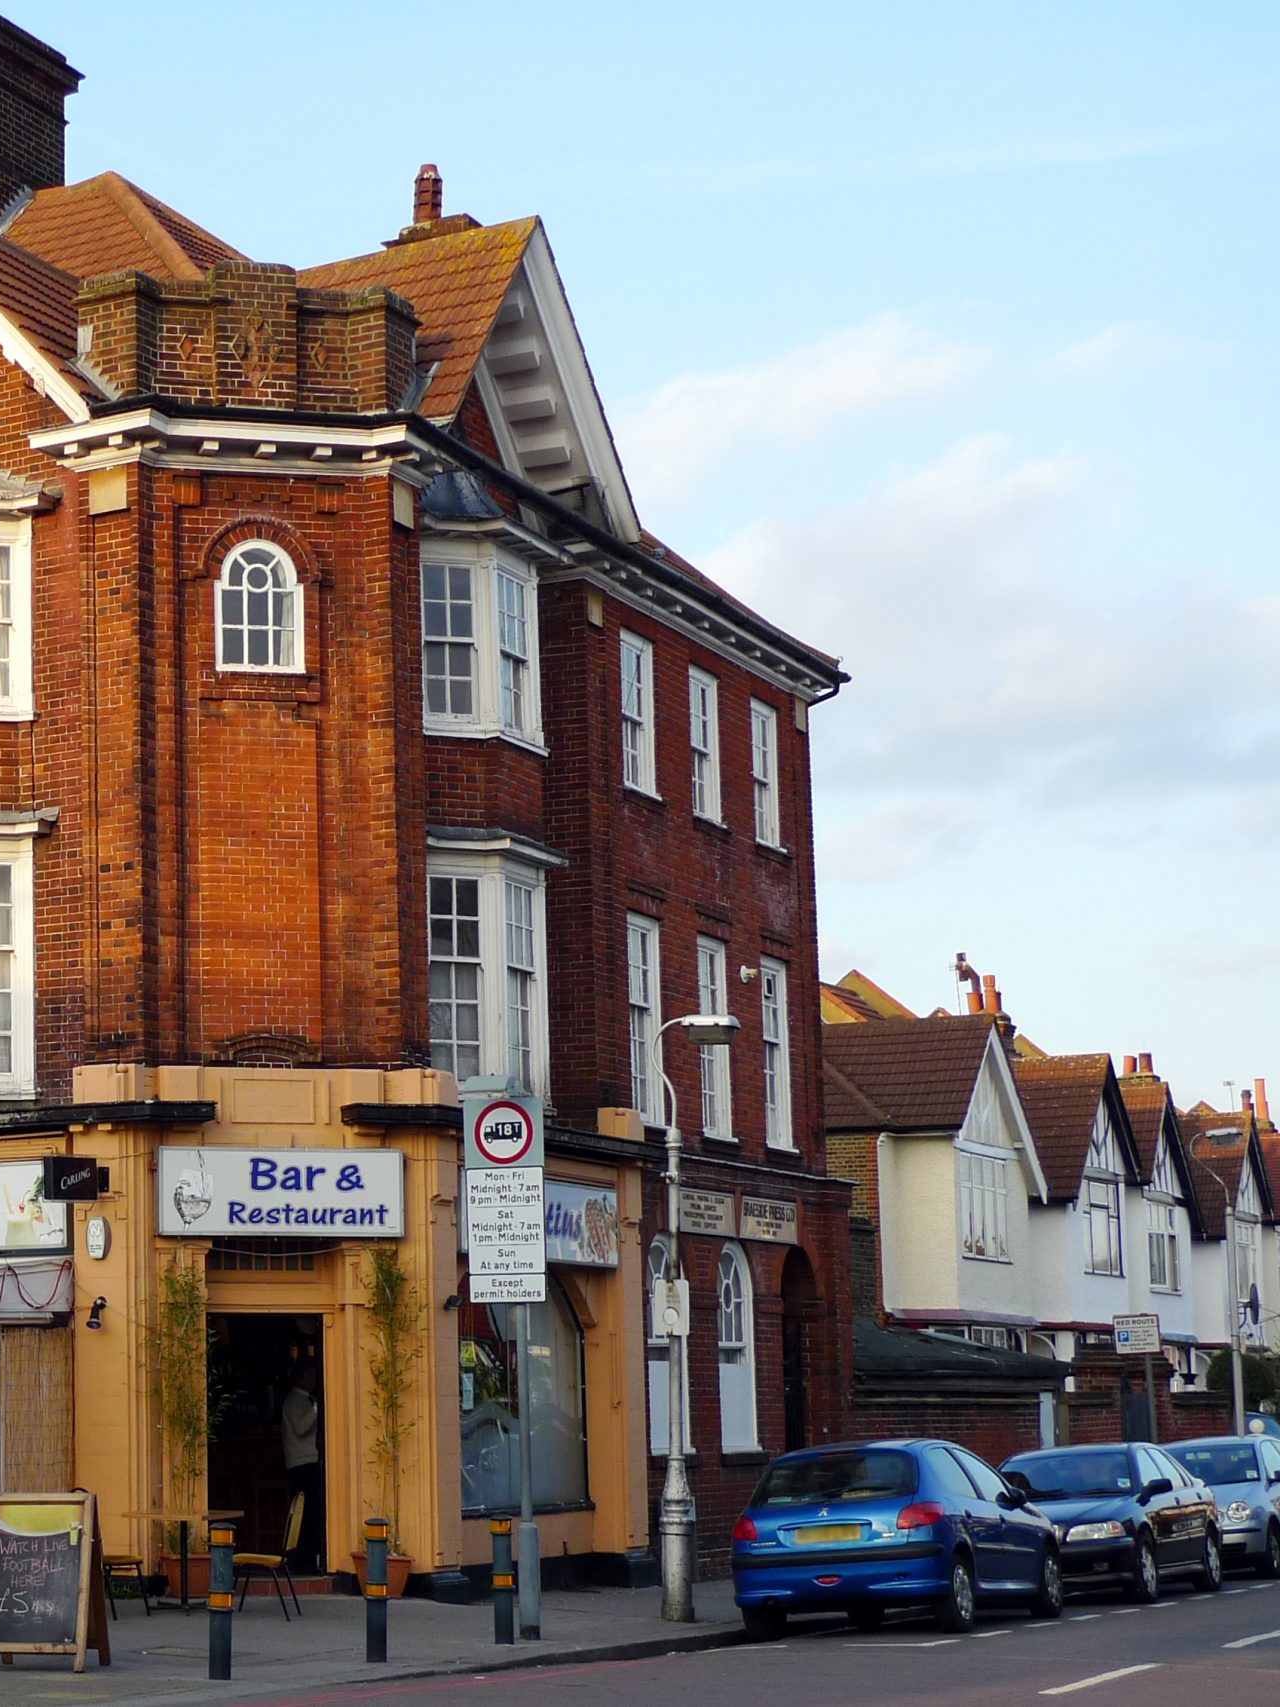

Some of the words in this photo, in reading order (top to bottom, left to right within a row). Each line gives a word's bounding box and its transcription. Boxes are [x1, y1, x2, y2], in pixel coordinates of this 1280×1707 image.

[60, 1167, 91, 1190] CARLING
[250, 1157, 326, 1191] Bar
[335, 1164, 364, 1191] &
[485, 1172, 504, 1181] Mon
[512, 1171, 524, 1180] Fri
[471, 1183, 512, 1195] Midnight
[499, 1193, 541, 1204] Midnight
[228, 1201, 389, 1225] Restaurant
[497, 1210, 514, 1219] Sat
[472, 1222, 513, 1232] Midnight
[498, 1232, 540, 1243] Midnight
[497, 1248, 516, 1257] Sun
[480, 1261, 490, 1270] At
[494, 1262, 510, 1271] any
[513, 1260, 534, 1269] time
[491, 1279, 524, 1288] Except
[474, 1289, 504, 1299] permit
[506, 1288, 542, 1298] holders
[0, 1538, 38, 1555] WATCH
[44, 1536, 68, 1552] LIVE
[2, 1557, 64, 1573] FOOTBALL
[11, 1574, 45, 1588] HERE
